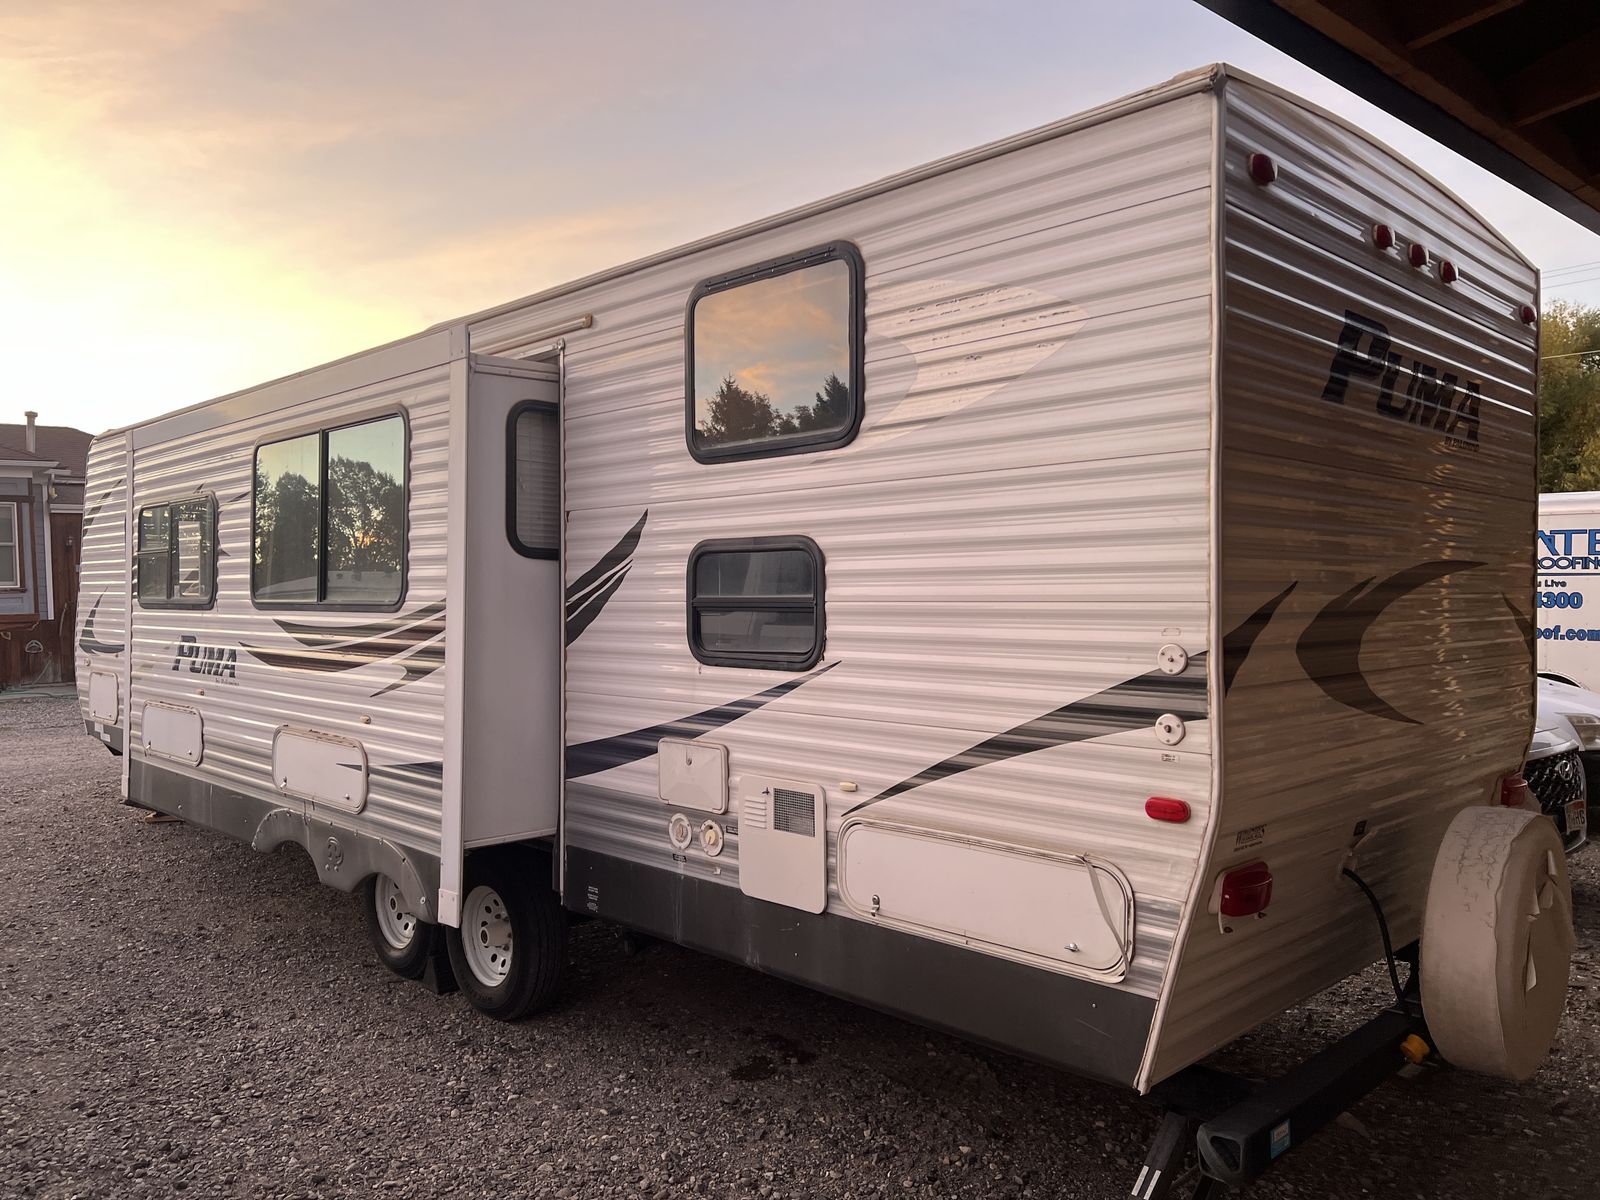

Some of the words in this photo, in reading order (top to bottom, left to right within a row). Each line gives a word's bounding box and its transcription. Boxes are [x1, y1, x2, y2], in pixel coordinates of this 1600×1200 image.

[1320, 309, 1481, 443] PUMA
[1537, 556, 1600, 570] OOFIN
[1544, 579, 1567, 588] Live
[172, 635, 237, 678] PUMA
